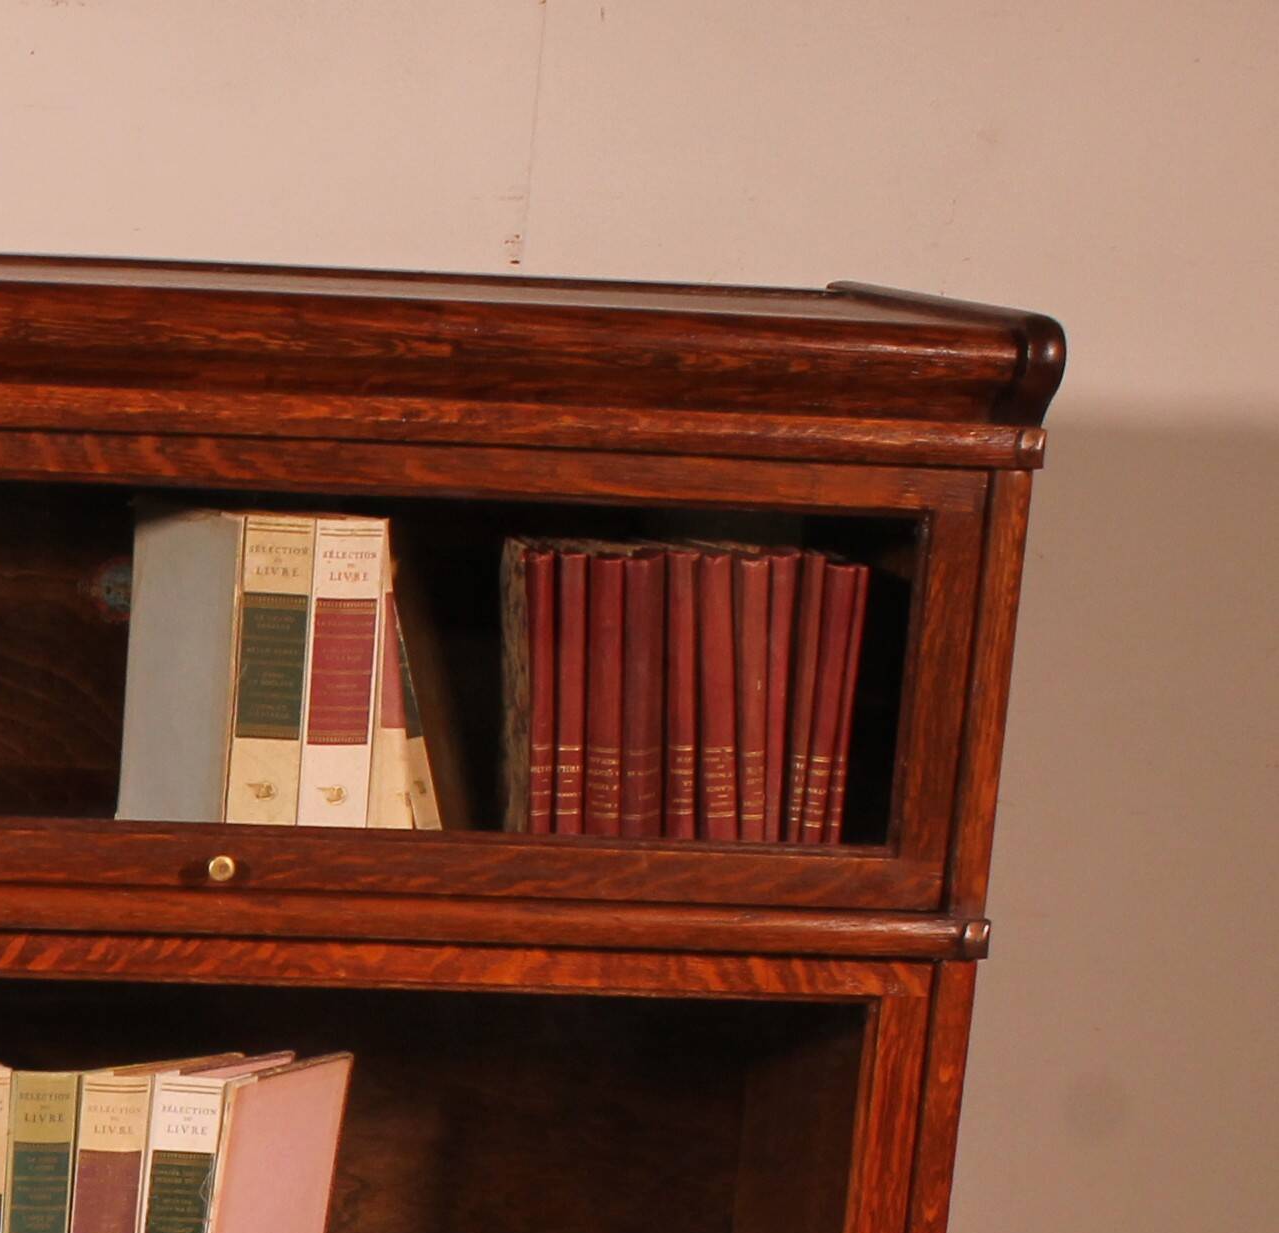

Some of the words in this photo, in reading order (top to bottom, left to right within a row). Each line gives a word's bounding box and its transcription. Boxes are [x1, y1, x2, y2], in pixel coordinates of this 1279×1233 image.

[322, 550, 378, 561] SÉLECTION
[255, 566, 301, 578] LIVRE
[329, 571, 370, 583] LIVRE
[93, 1124, 135, 1136] LIVRE
[166, 1124, 209, 1136] LIVRE
